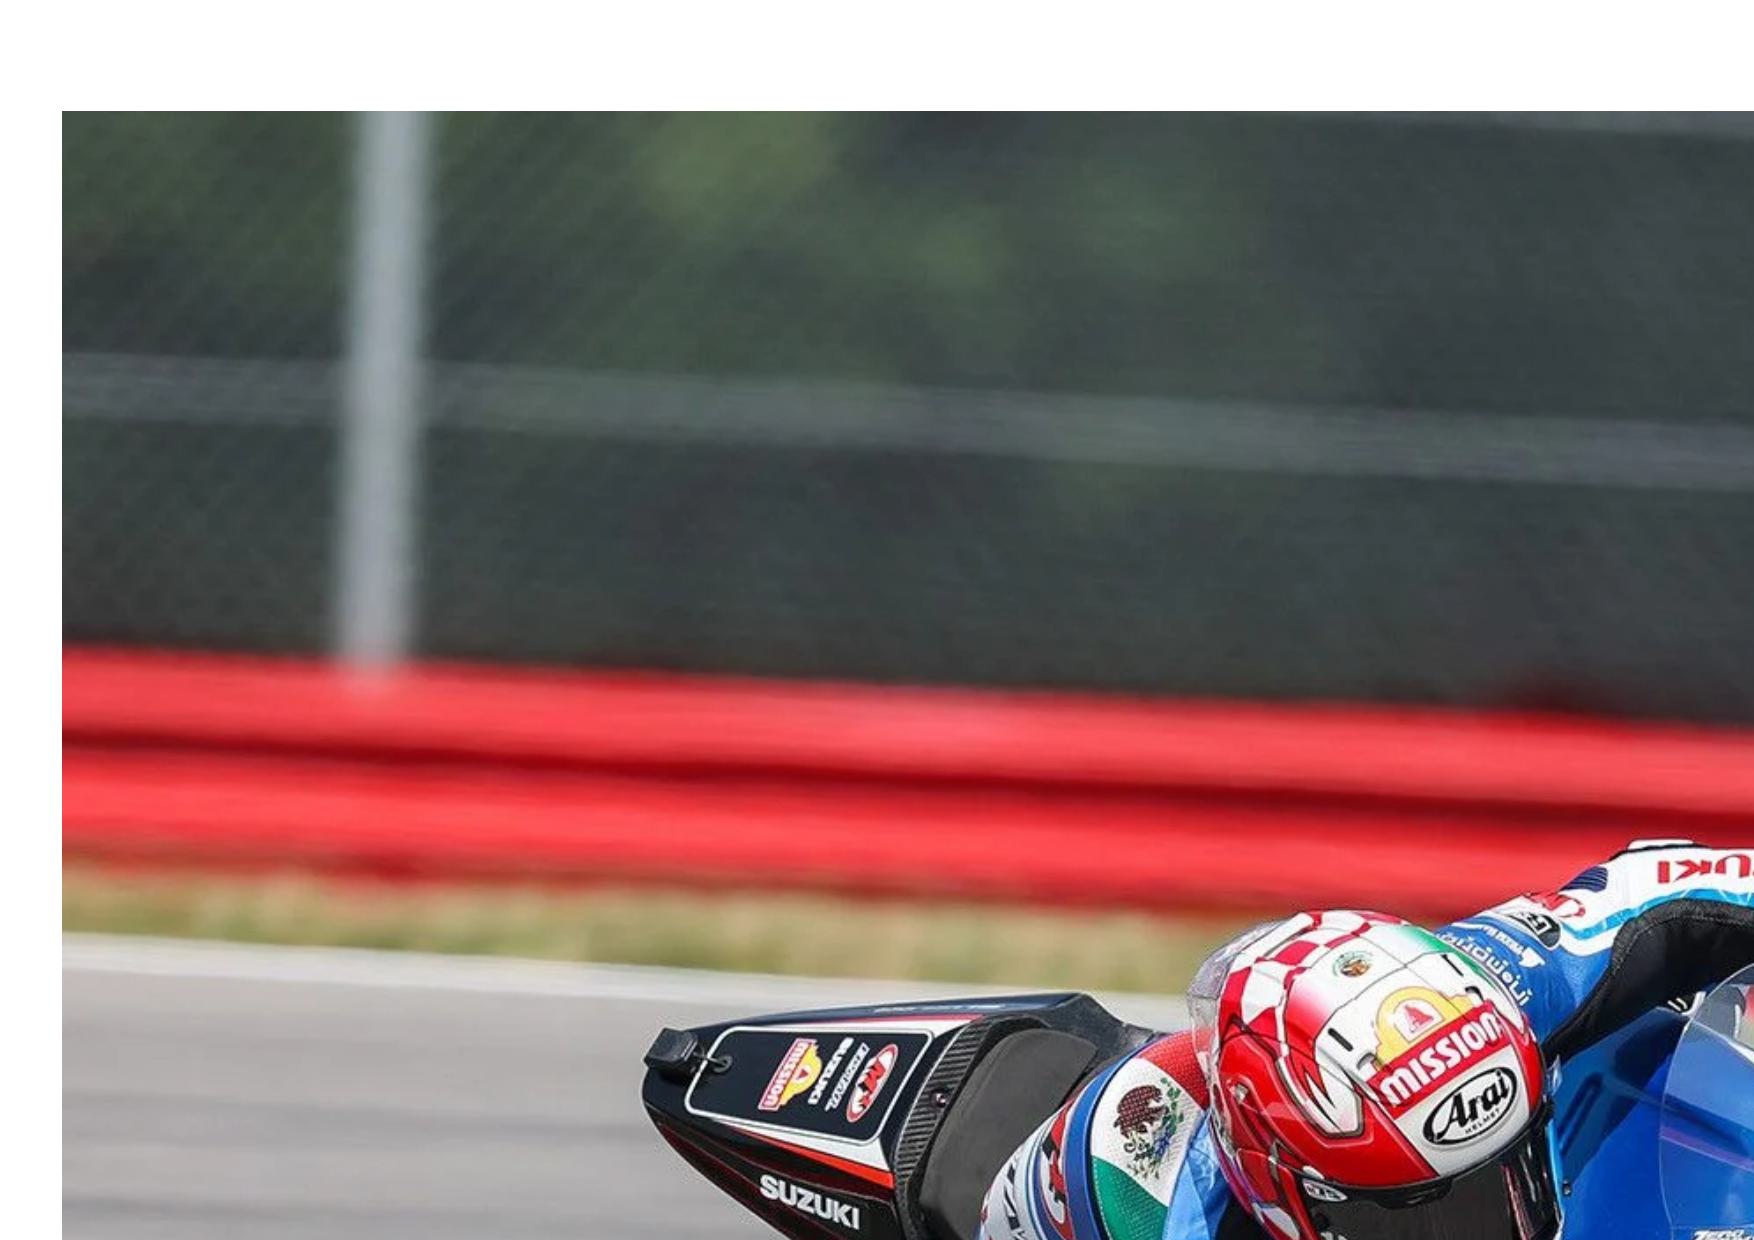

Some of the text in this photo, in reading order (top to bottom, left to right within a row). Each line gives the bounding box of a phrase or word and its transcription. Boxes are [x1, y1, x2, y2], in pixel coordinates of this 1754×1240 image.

[808, 1036, 854, 1105] SUZUKI
[1436, 1069, 1510, 1141] Arai
[758, 1174, 862, 1231] SUZUKI
